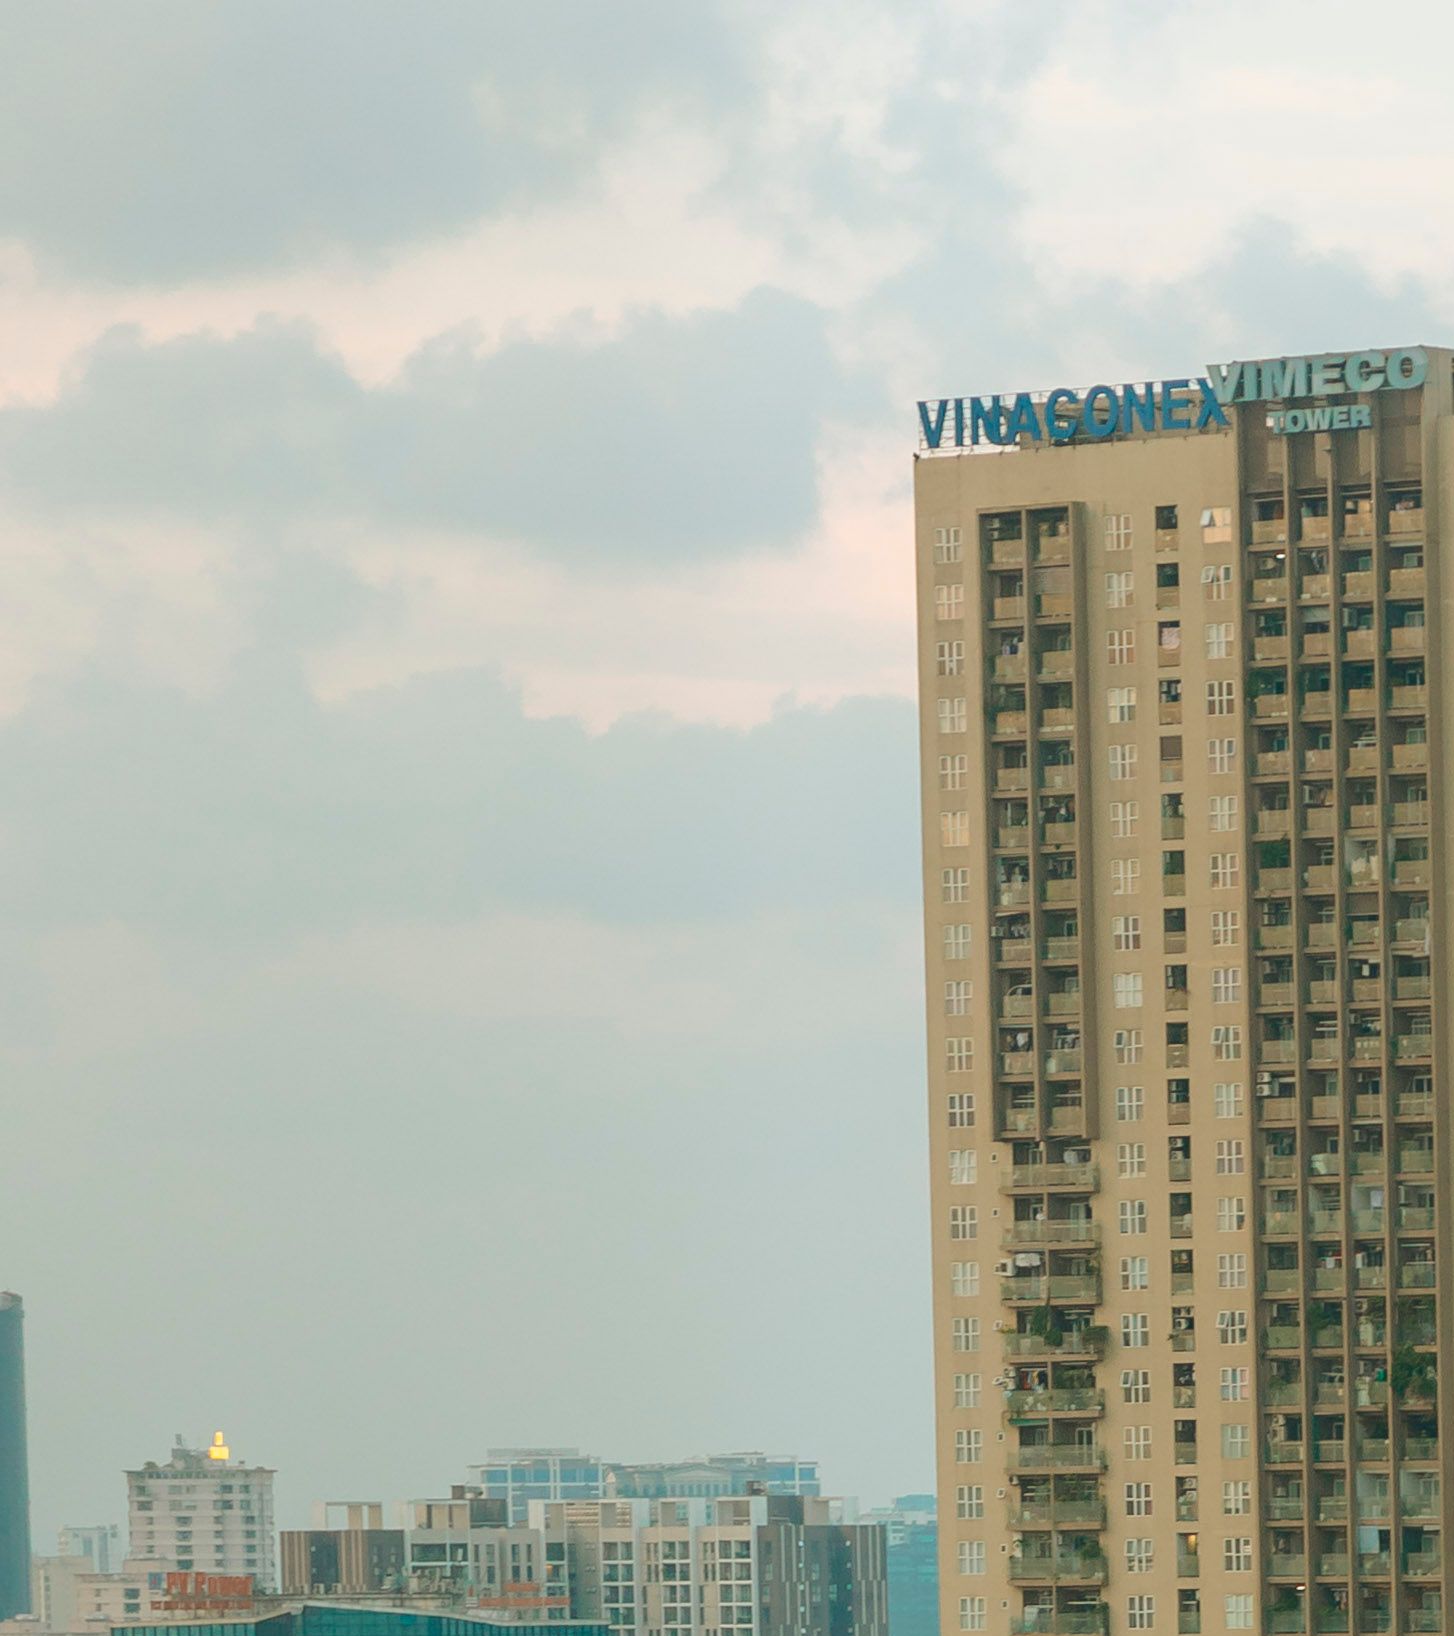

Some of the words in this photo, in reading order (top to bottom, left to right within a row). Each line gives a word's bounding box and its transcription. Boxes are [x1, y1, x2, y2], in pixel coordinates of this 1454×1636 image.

[1206, 349, 1429, 405] VIMECO
[916, 377, 1230, 449] VINACONEX
[1266, 405, 1373, 436] TOWER
